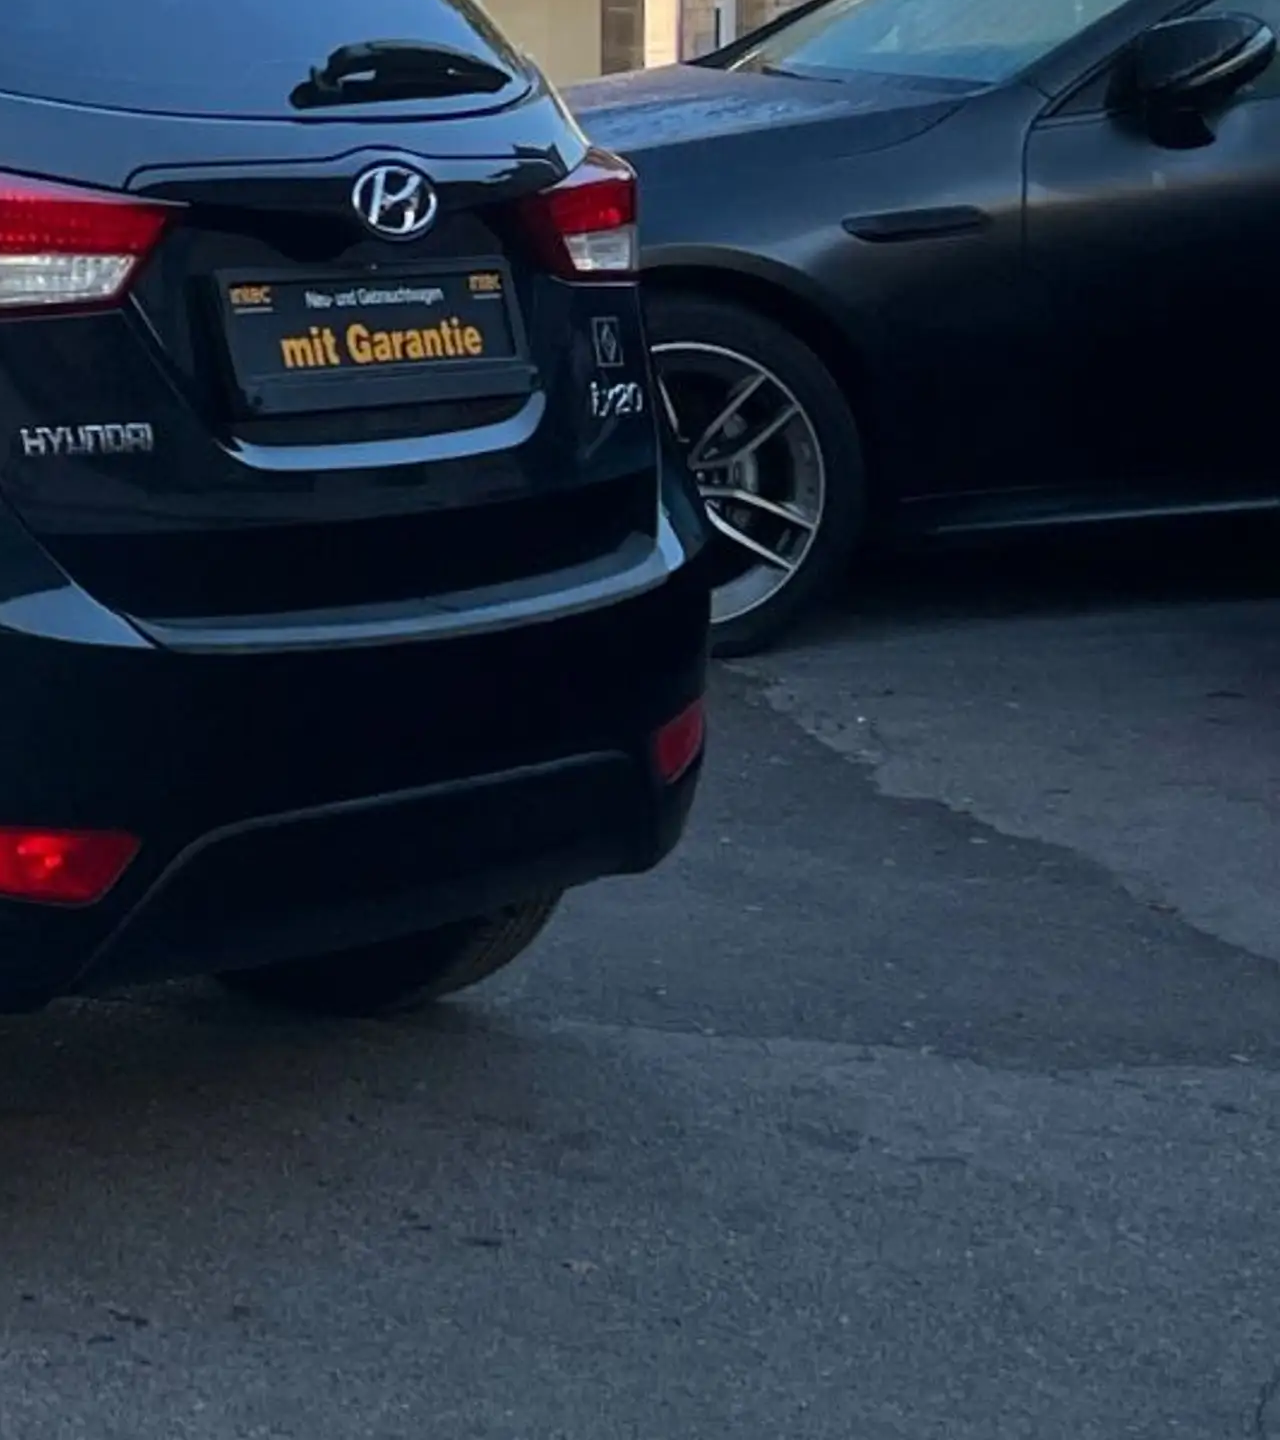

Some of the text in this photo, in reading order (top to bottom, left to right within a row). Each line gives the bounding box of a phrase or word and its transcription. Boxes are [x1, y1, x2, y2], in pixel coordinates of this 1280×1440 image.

[335, 288, 357, 306] und
[280, 316, 483, 369] mit Garantie
[19, 421, 154, 456] HYUNDAI
